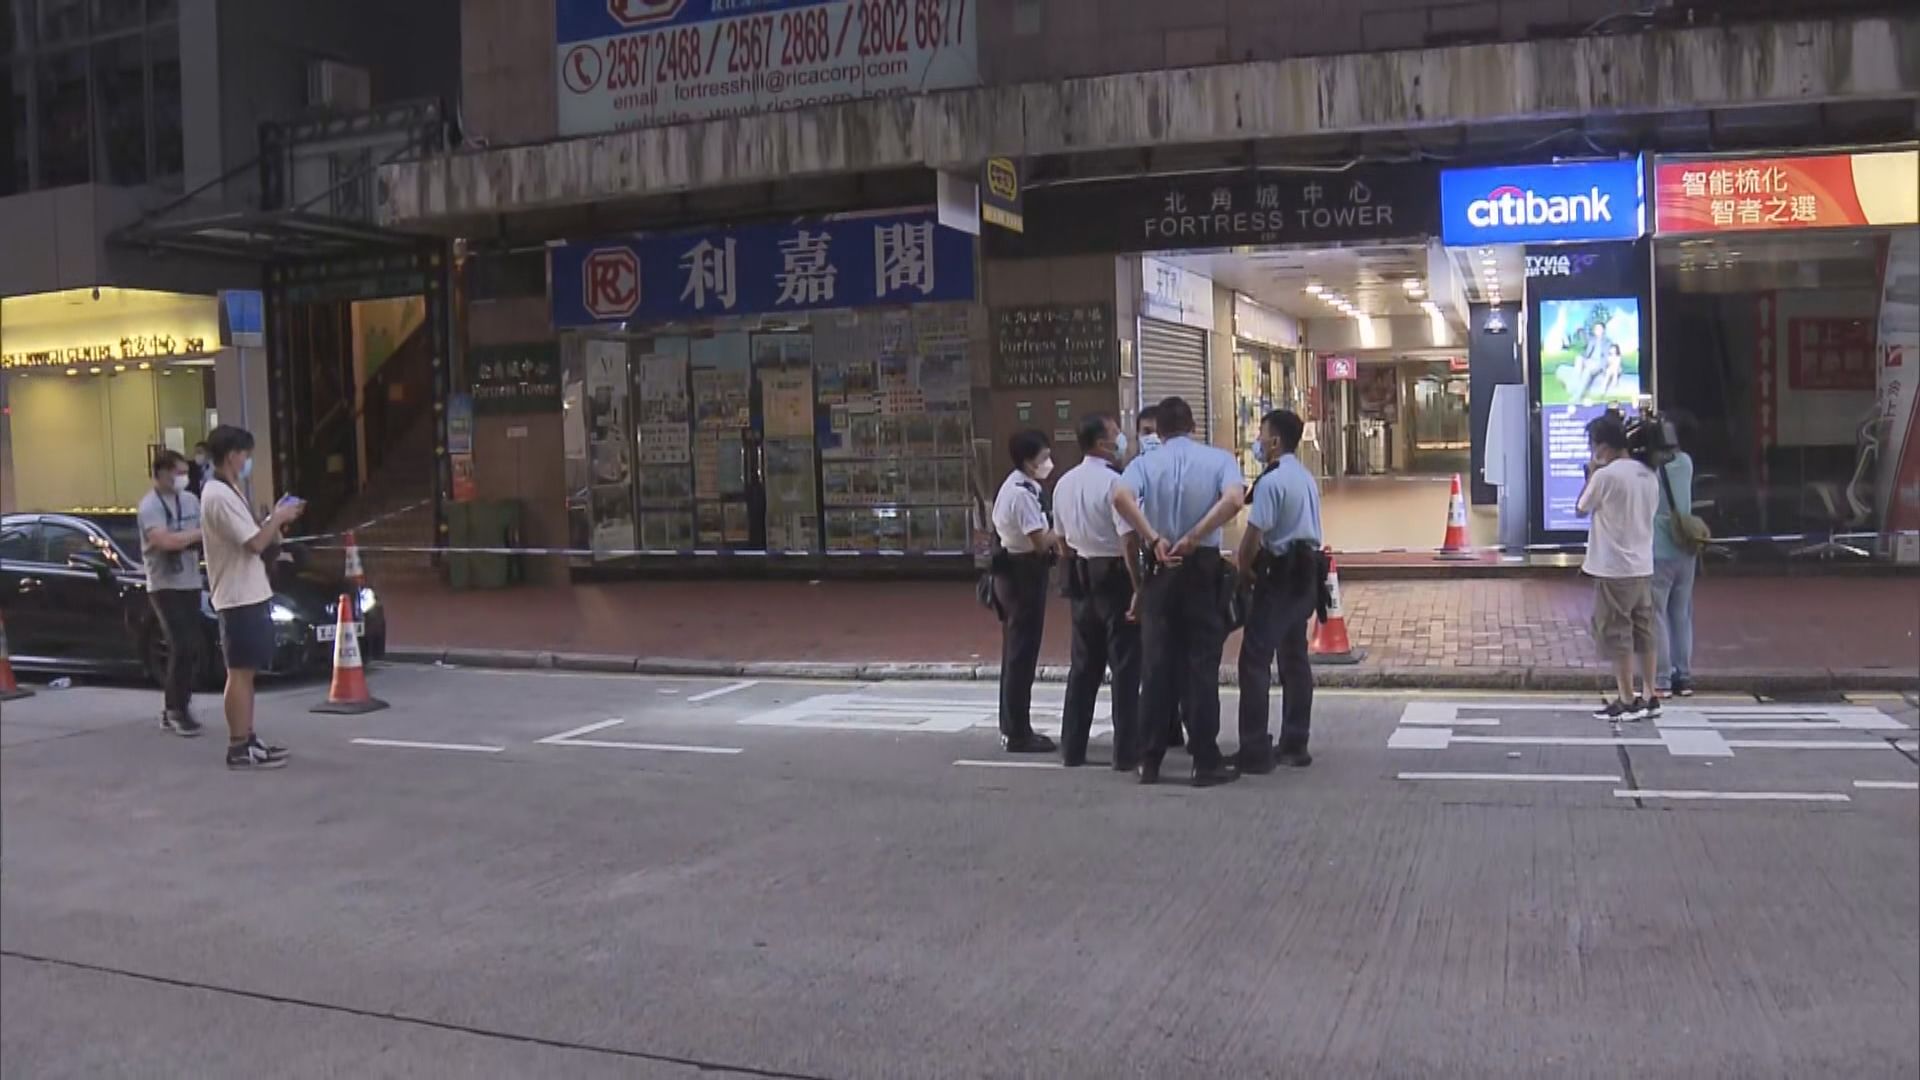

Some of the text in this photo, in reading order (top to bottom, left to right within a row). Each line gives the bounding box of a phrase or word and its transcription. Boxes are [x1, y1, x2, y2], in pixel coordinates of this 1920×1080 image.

[606, 35, 649, 90] 2567
[655, 26, 702, 83] 2468
[727, 16, 774, 73] 2567
[780, 7, 830, 66] 2868
[857, 0, 909, 57] 2802
[613, 87, 658, 110] email
[1164, 181, 1372, 213] 北角城中心
[1681, 165, 1788, 197] 智能梳化
[1144, 206, 1394, 239] FORTRESS TOWER
[1467, 185, 1612, 228] citibank
[1710, 195, 1817, 226] 智者之選
[678, 221, 936, 310] 利嘉閣
